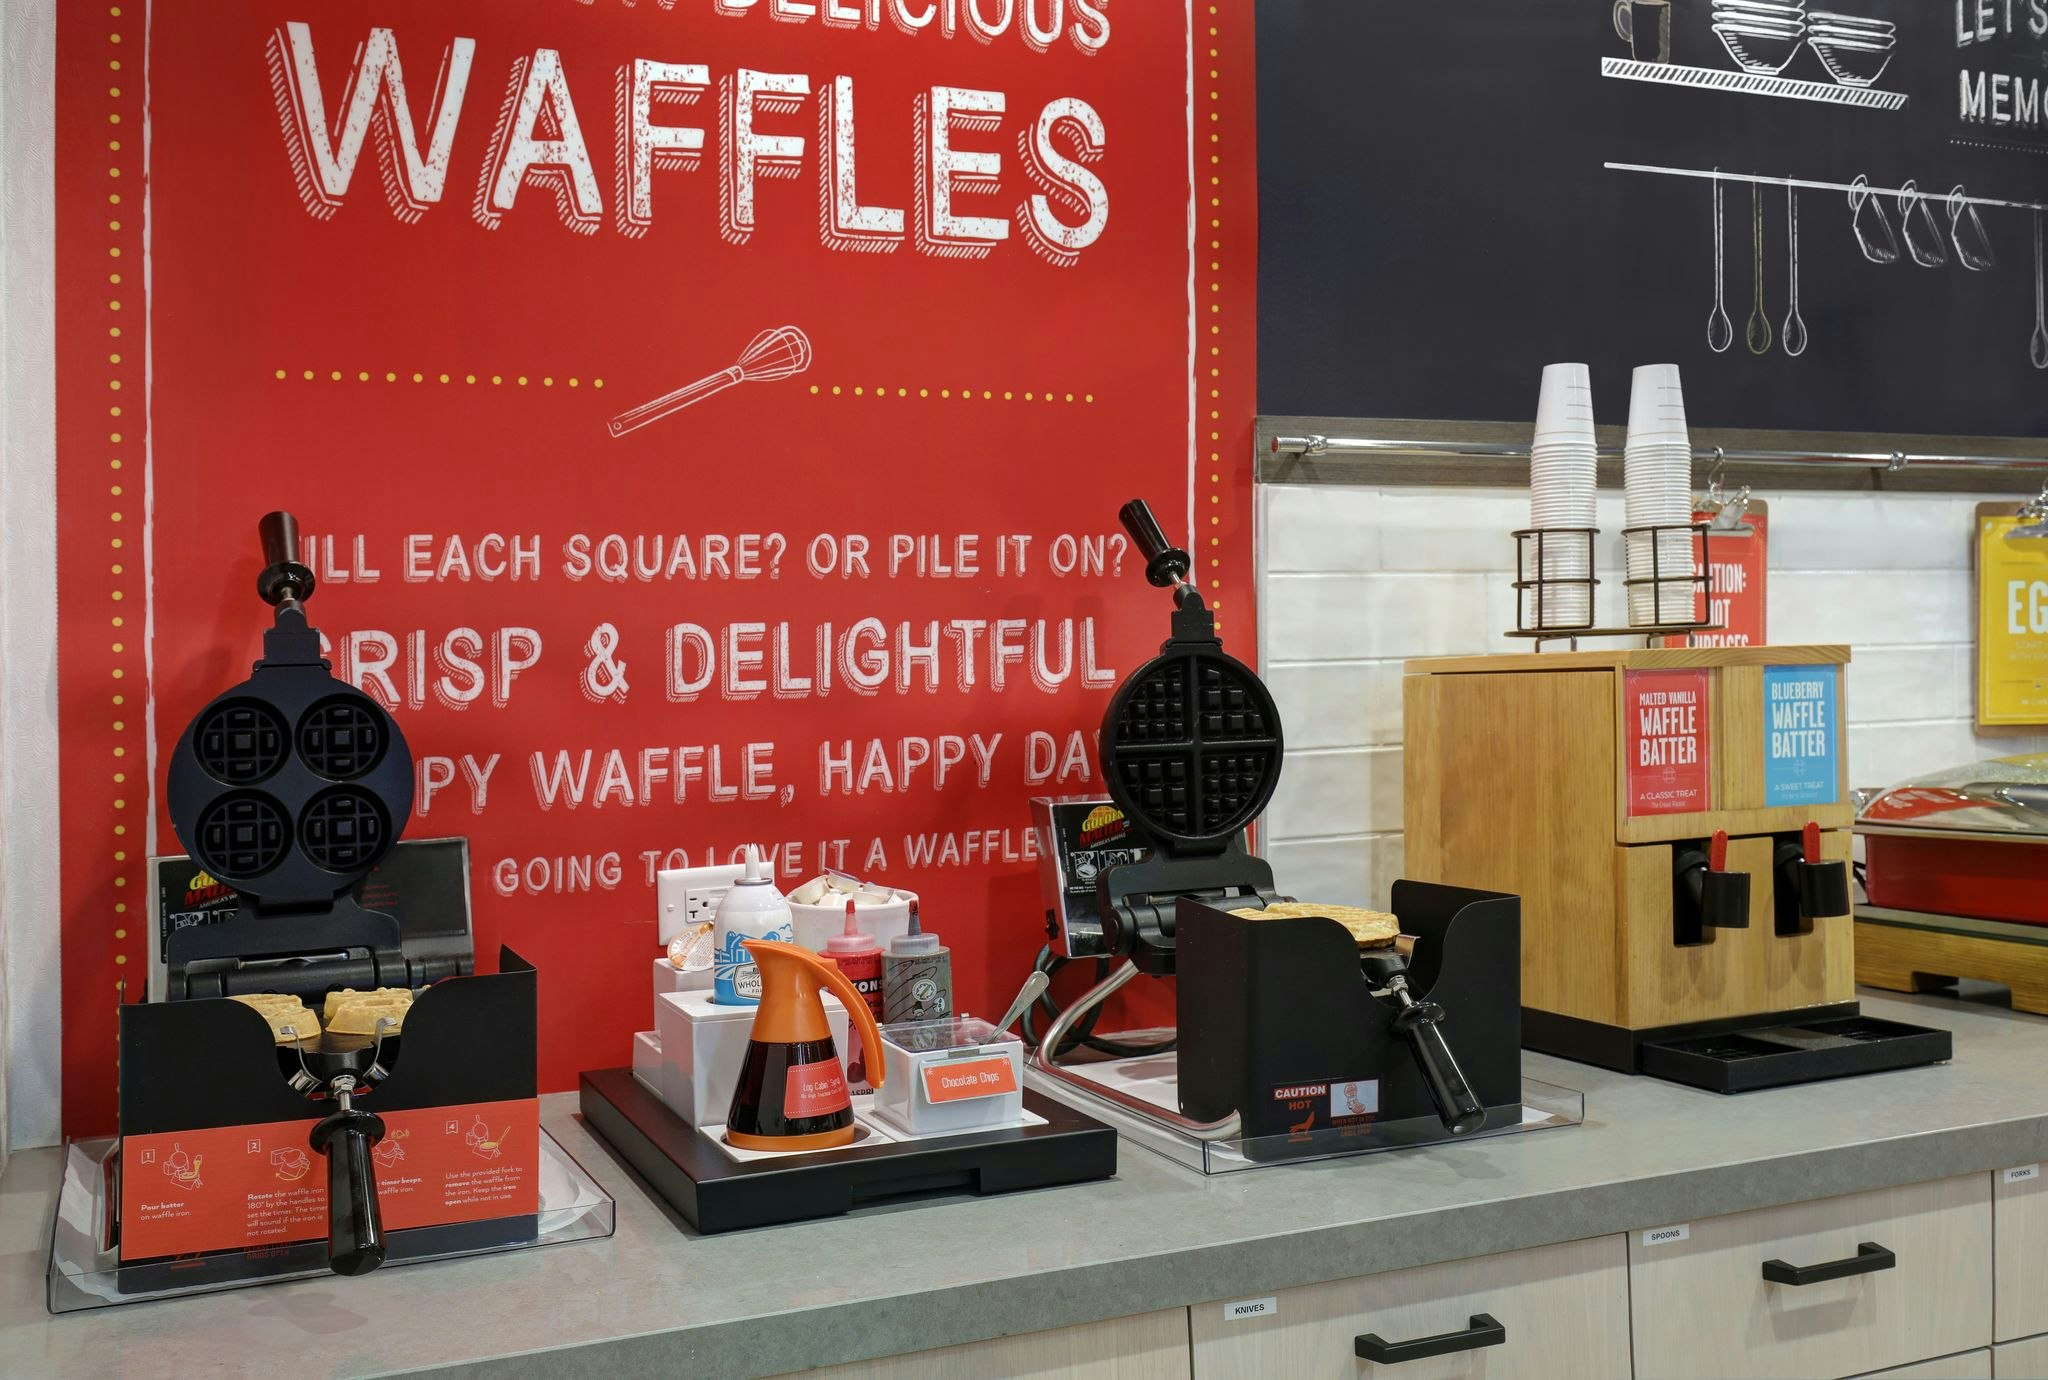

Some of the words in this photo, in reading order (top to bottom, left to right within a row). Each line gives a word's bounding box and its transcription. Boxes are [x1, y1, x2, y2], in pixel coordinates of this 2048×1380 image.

[264, 20, 1110, 269] WAFFLES
[300, 534, 381, 583] ILL
[403, 533, 541, 583] EACH
[562, 532, 787, 583] SQUARE?
[806, 533, 871, 579] OR
[889, 534, 980, 578] PILE
[996, 534, 1033, 578] IT
[1049, 533, 1128, 577] ON?
[580, 622, 631, 704] &
[665, 617, 1117, 702] DELIGHTFUL
[1772, 681, 1824, 700] BLUEBERRY
[1640, 692, 1667, 706] MALTED
[1669, 691, 1696, 705] VANILLA
[1640, 706, 1697, 736] WAFFLE
[1772, 701, 1825, 729] WAFFLE
[1772, 730, 1825, 759] BATTER
[1640, 736, 1697, 767] BATTER
[529, 742, 795, 811] WAFFLE,
[818, 732, 1003, 795] HAPPY
[1024, 729, 1101, 786] DA
[1780, 782, 1803, 791] SWEET
[1804, 781, 1824, 790] TREAT
[1646, 791, 1675, 800] CLASSIC
[1676, 788, 1698, 798] TREAT
[493, 851, 623, 896] GOING
[818, 840, 850, 875] IT
[863, 836, 888, 873] A
[941, 1075, 977, 1089] Chocolate
[979, 1072, 999, 1084] Chips
[1274, 1085, 1327, 1099] CAUTION
[1288, 1100, 1313, 1111] HOT
[460, 1170, 471, 1178] the
[472, 1167, 500, 1177] provided
[2011, 1169, 2031, 1178] FORKS
[381, 1177, 401, 1186] timer
[483, 1176, 504, 1184] waffle
[247, 1193, 273, 1201] Rotate
[274, 1189, 286, 1198] the
[287, 1188, 310, 1196] waffle
[140, 1204, 160, 1212] Pour
[161, 1202, 184, 1211] batter
[265, 1201, 275, 1209] by
[289, 1197, 316, 1205] handles
[152, 1211, 175, 1219] waffle
[260, 1217, 282, 1226] sound
[1651, 1229, 1680, 1241] SPOONS
[1235, 1304, 1265, 1315] KNIVES
